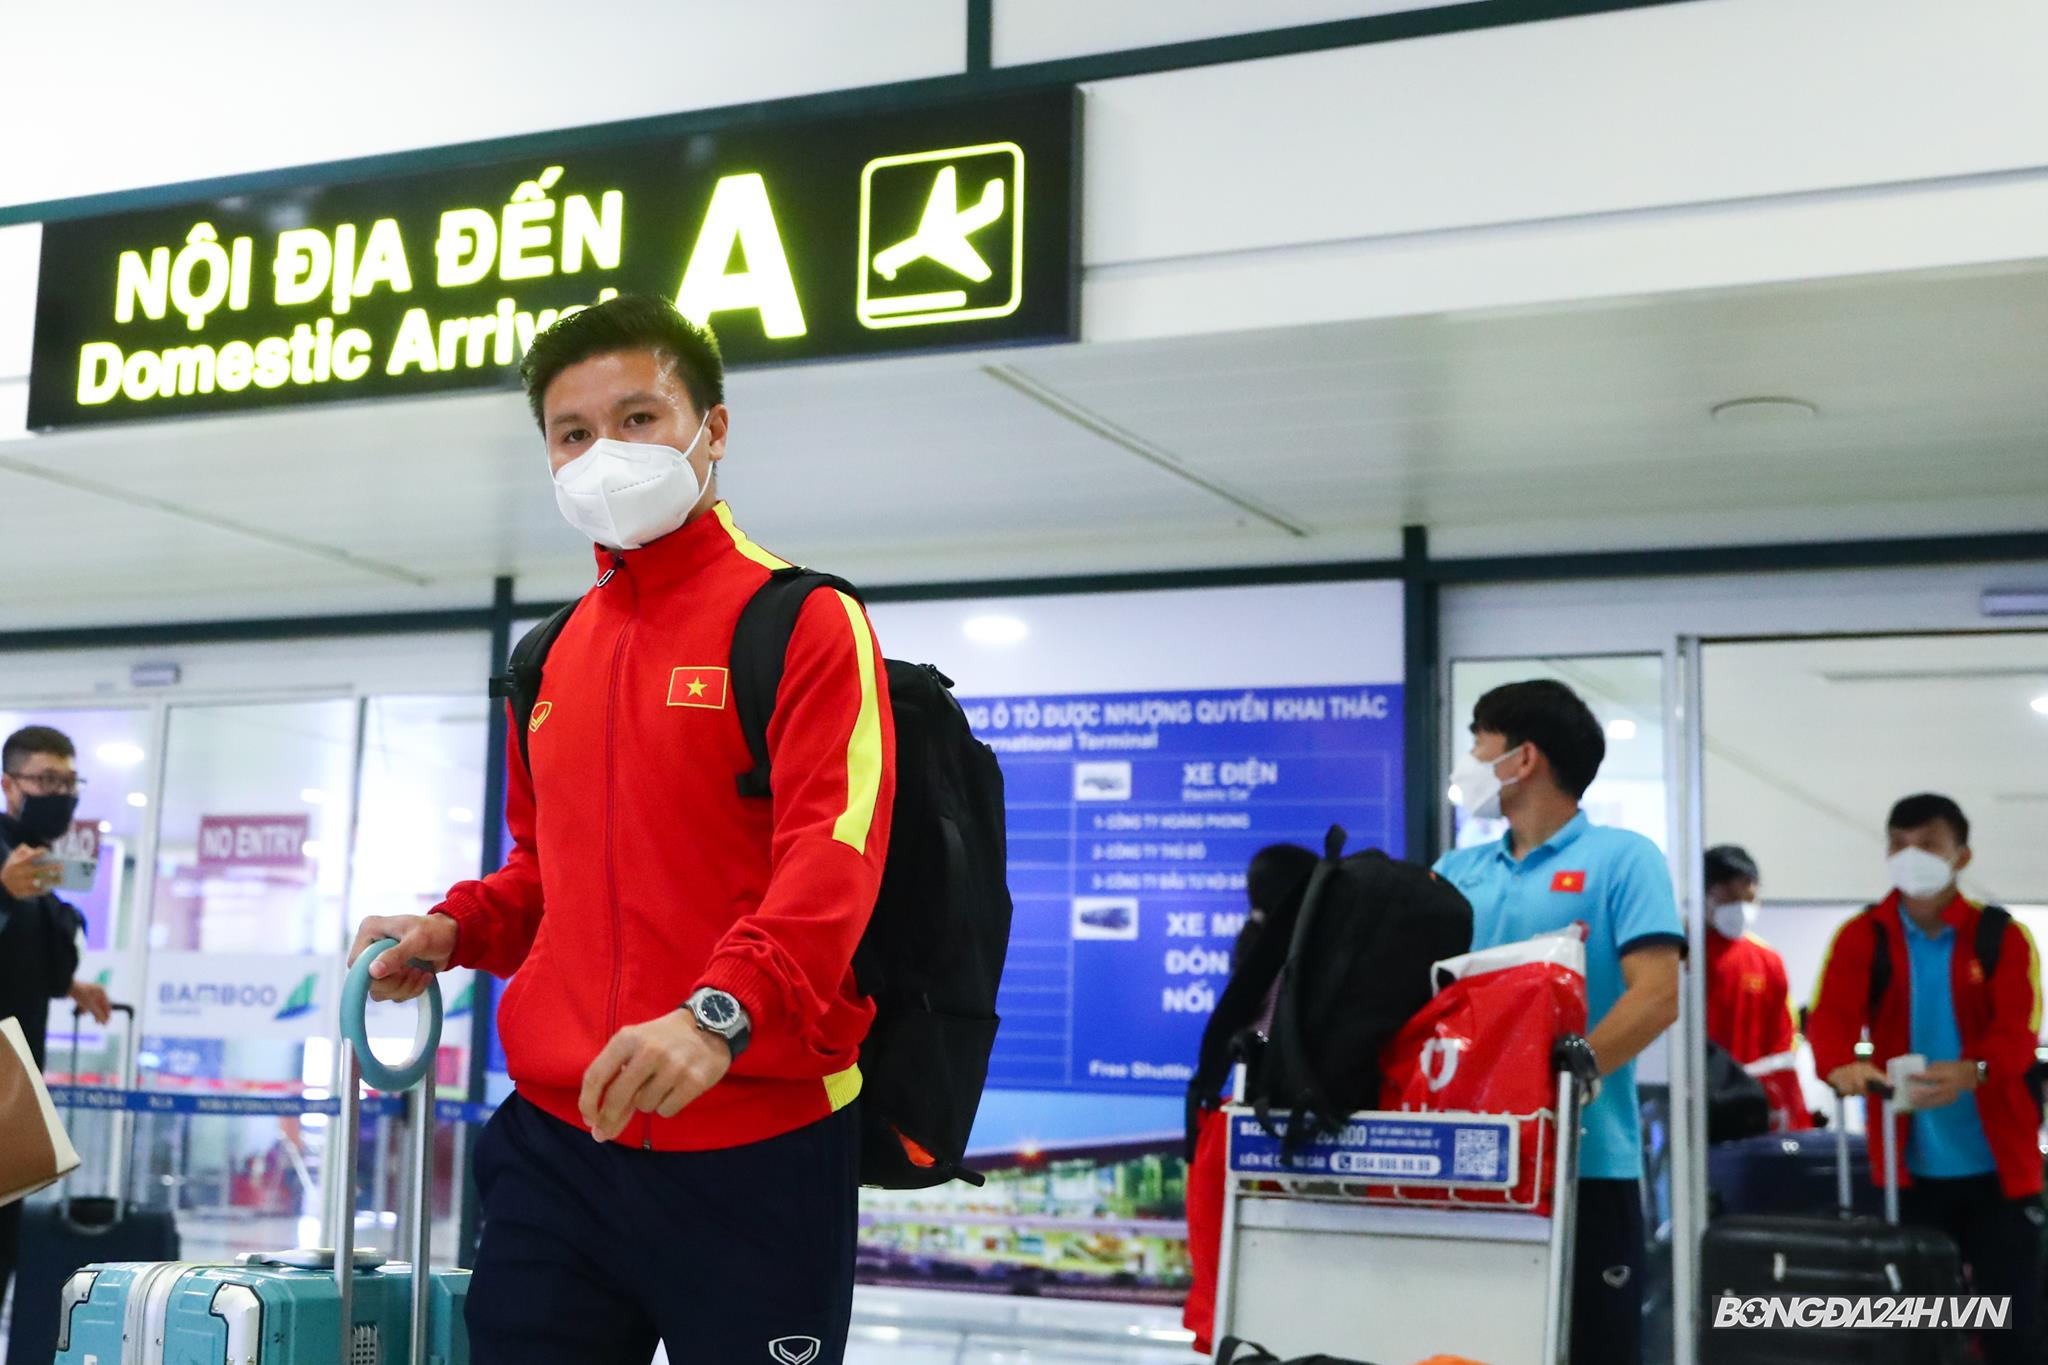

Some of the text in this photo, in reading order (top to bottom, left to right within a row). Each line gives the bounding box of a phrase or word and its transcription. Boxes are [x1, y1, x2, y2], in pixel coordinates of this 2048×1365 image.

[115, 165, 625, 331] NỘI ĐỊA ĐẾN
[675, 171, 808, 339] A
[77, 286, 619, 406] Domestic Arriv
[1273, 697, 1325, 722] KHAI
[1078, 731, 1159, 750] Terminal
[1183, 762, 1215, 786] XE
[204, 826, 302, 858] NO ENTRY
[1167, 912, 1205, 937] XE
[1089, 1060, 1128, 1078] Free
